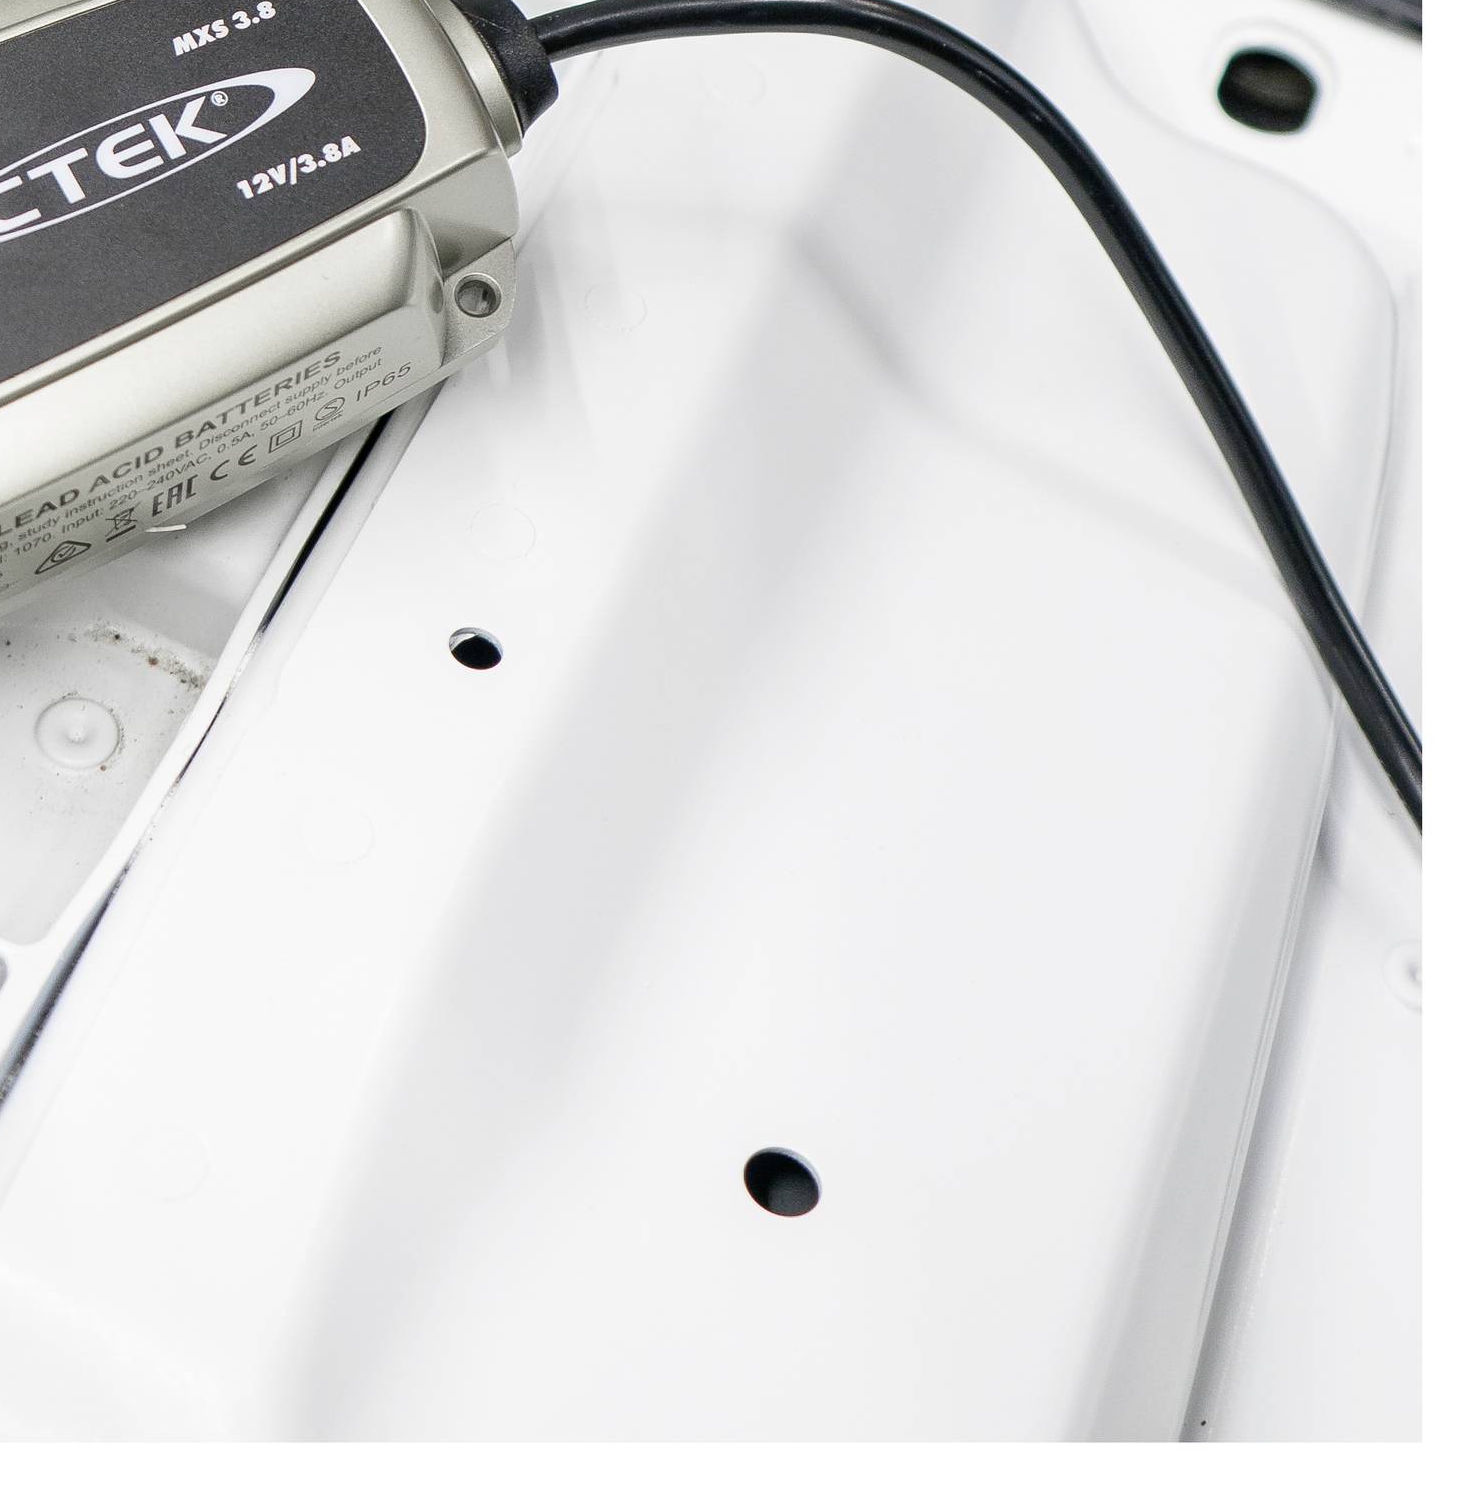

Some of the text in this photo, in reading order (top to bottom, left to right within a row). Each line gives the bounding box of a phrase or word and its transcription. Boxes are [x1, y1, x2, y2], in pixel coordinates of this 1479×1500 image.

[173, 0, 277, 57] MXS 3.8
[236, 134, 361, 200] 12V/3.8A
[88, 445, 165, 493] ACID
[174, 350, 341, 449] BATTERIES
[356, 361, 412, 402] IP65
[18, 514, 61, 541] study
[64, 473, 143, 519] instruction
[199, 401, 281, 451] Disconnect
[285, 373, 333, 404] supply
[336, 346, 382, 376] before
[62, 506, 104, 534] Input:
[334, 357, 383, 390] Output
